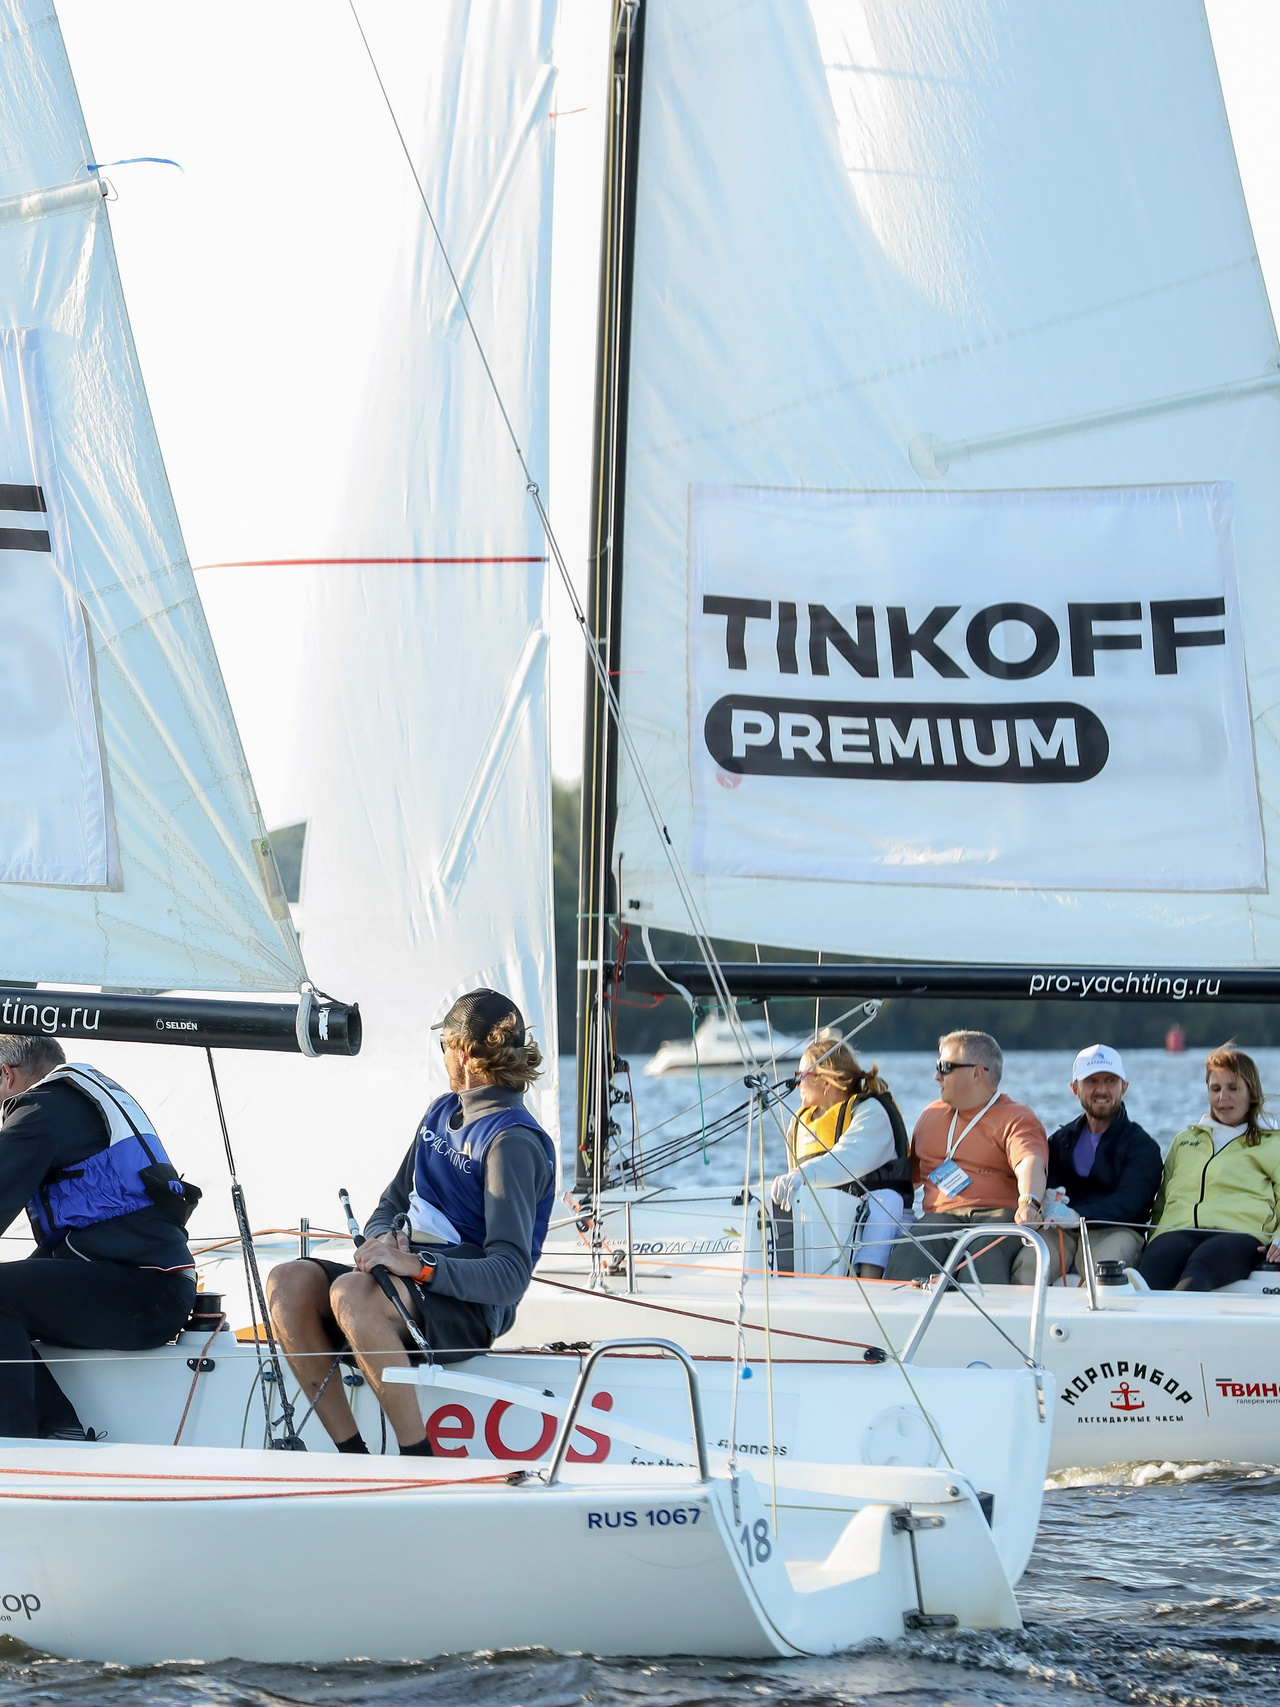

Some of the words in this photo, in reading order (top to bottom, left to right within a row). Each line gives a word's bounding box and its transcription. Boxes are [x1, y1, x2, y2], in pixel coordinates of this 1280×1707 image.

[702, 594, 1226, 681] TINKOFF
[730, 708, 1080, 767] PREMIUM
[1028, 971, 1221, 1000] pro-yachting.ru
[1060, 1360, 1194, 1407] МОРПРИБОР
[1214, 1378, 1280, 1398] ТВИН
[1077, 1415, 1152, 1424] ЛЕГЕНДАРНЫЕ
[1155, 1414, 1184, 1422] ЧАСЫ
[587, 1511, 639, 1530] RUS
[645, 1508, 702, 1527] 1067
[740, 1518, 773, 1568] 18
